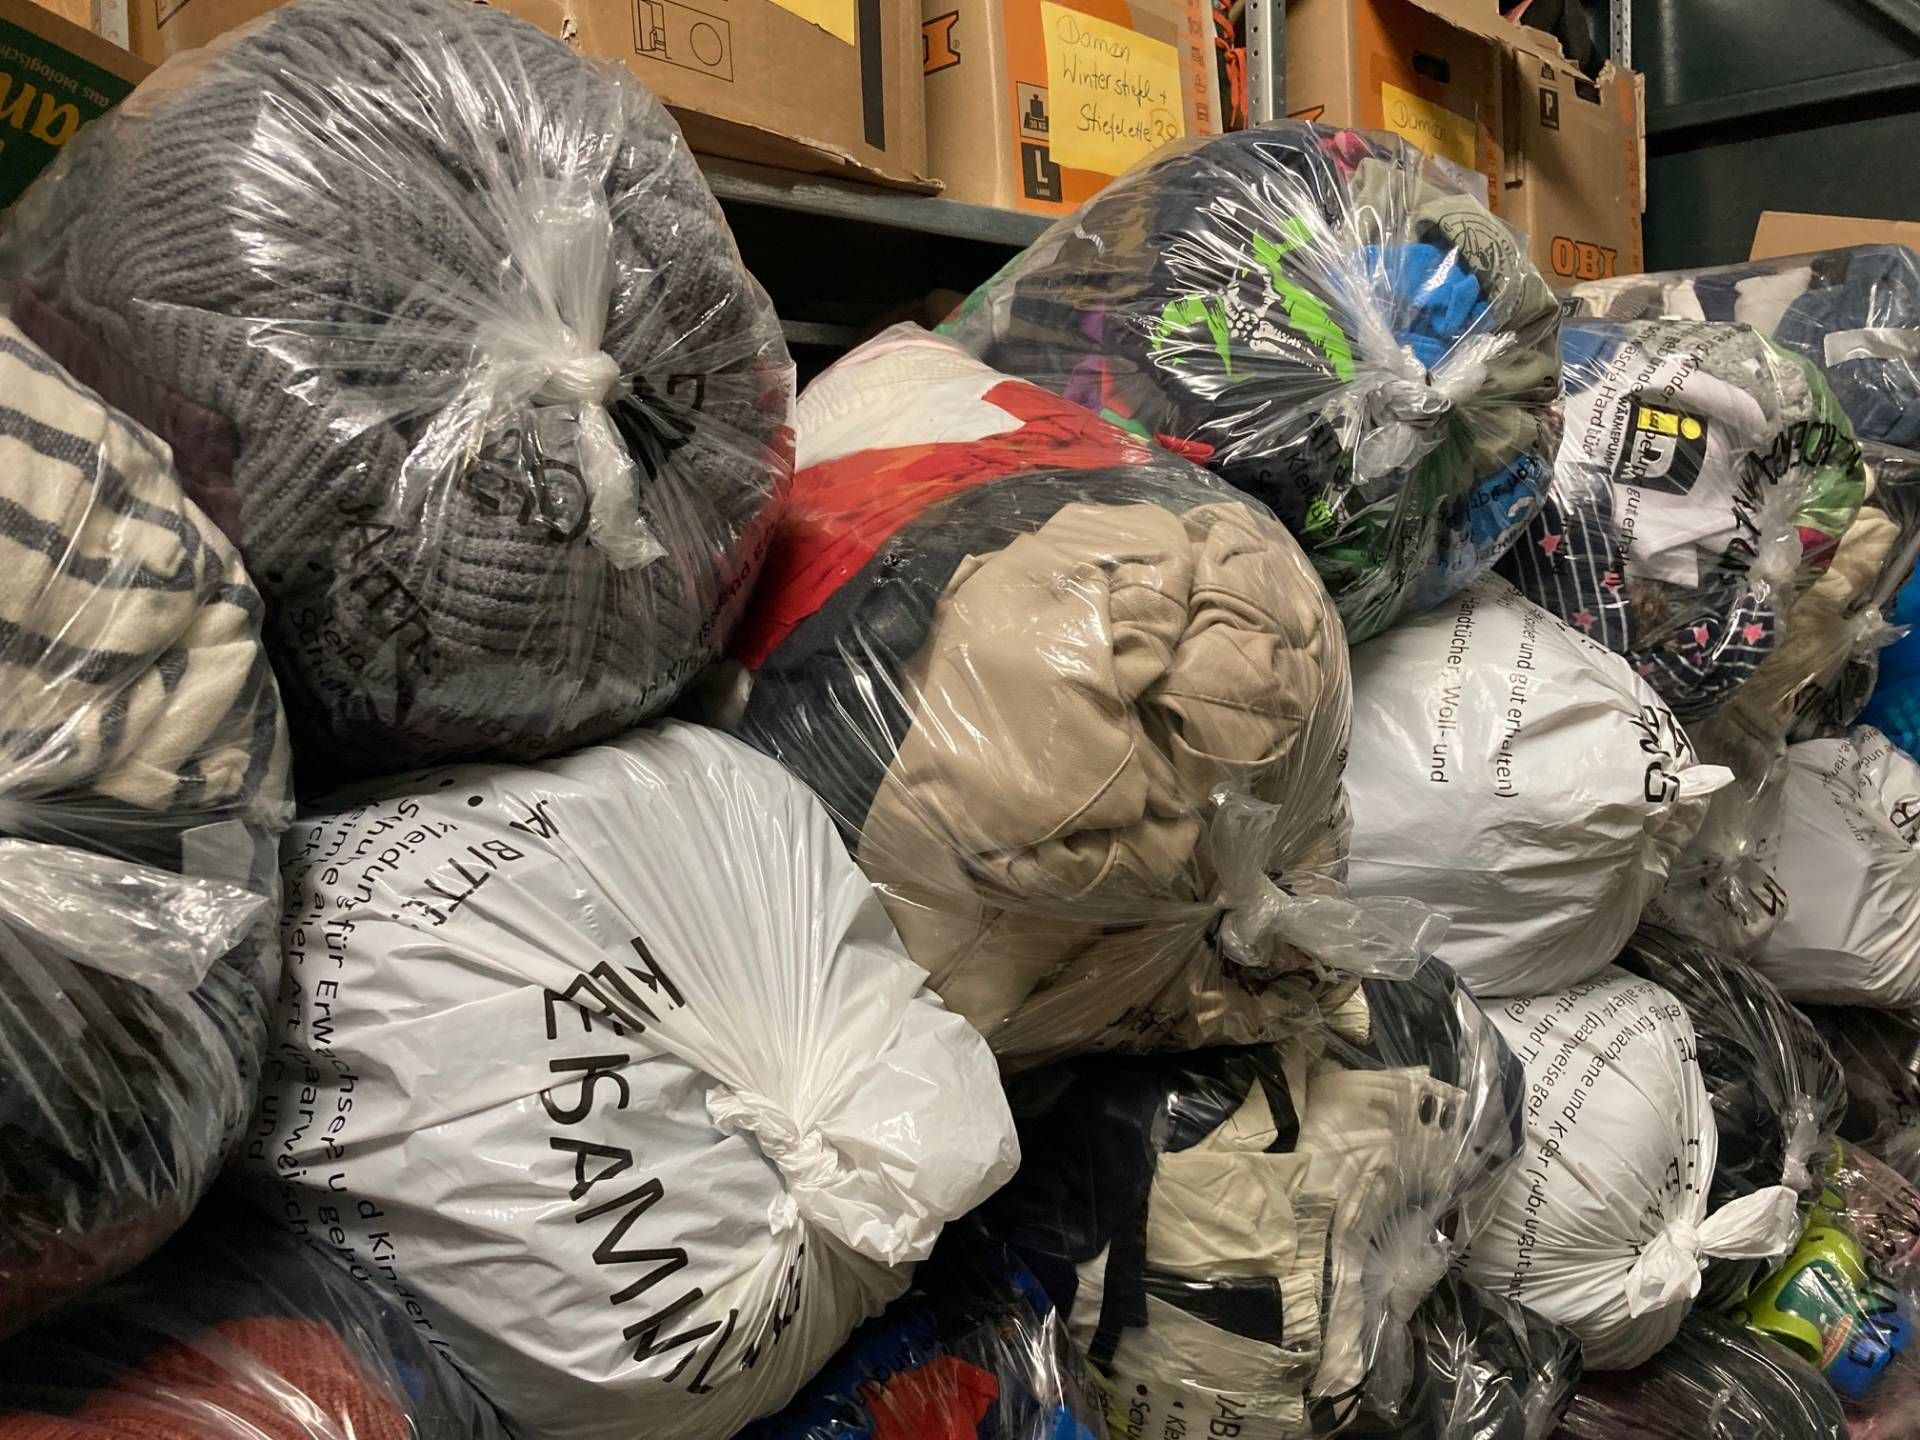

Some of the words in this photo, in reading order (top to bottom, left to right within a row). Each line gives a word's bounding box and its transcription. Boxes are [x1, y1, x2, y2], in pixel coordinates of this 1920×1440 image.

[1551, 235, 1619, 280] OBI
[1516, 640, 1536, 671] und
[1508, 672, 1529, 705] gut
[1429, 743, 1449, 783] und
[326, 918, 356, 969] für
[1529, 1013, 1559, 1047] und
[1542, 1010, 1606, 1087] (paarweise
[1561, 1087, 1588, 1124] und
